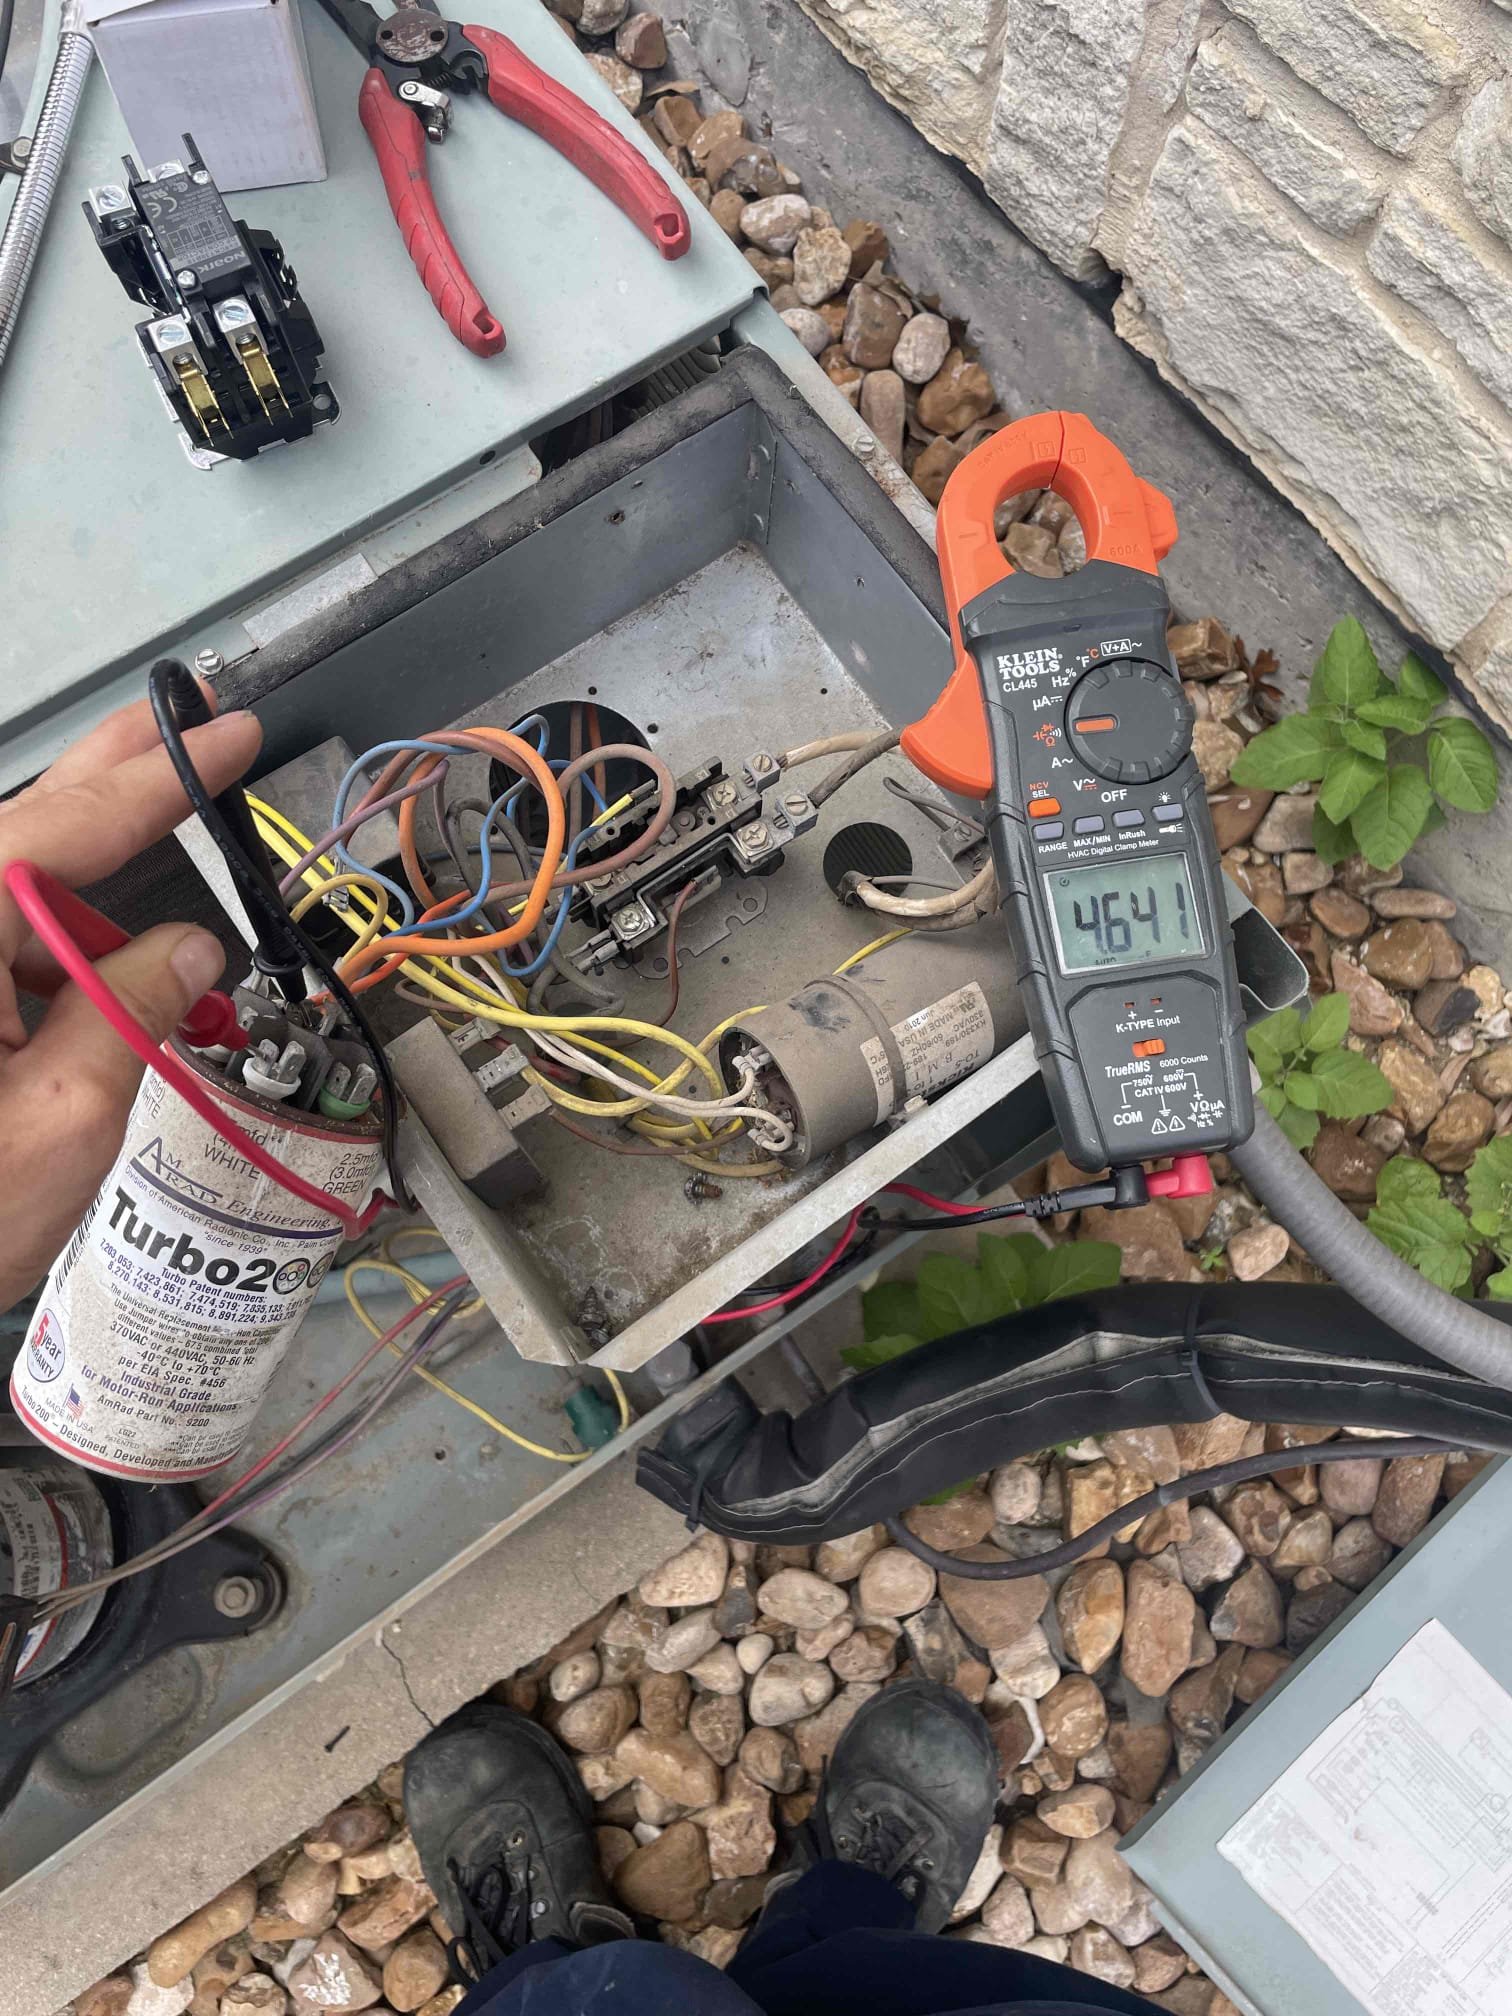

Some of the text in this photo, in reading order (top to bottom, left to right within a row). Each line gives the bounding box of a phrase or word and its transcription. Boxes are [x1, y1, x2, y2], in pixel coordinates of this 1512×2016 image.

[997, 648, 1058, 668] KLEIN
[999, 660, 1061, 680] TOOLS
[1002, 678, 1038, 693] CL445
[1029, 781, 1050, 791] NCV
[1032, 789, 1050, 799] SEL
[1101, 788, 1128, 803] OFF
[1073, 834, 1111, 848] MAX/MIN
[1118, 829, 1147, 841] InRush
[1038, 841, 1068, 854] RANGE
[1067, 838, 1160, 860] HVAC Digital Clamp Meter
[898, 1012, 955, 1048] MADE IN USA
[1116, 1015, 1181, 1033] K-TYPE Input
[1105, 1054, 1209, 1078] TrueRMS 6000 Counts
[1134, 1083, 1187, 1098] CAT IV 600V
[1113, 1110, 1143, 1126] COM
[204, 1143, 261, 1181] WHITE
[322, 1179, 367, 1195] GREEN
[125, 1164, 149, 1193] Division
[160, 1195, 203, 1225] American
[204, 1220, 249, 1242] Radionic
[161, 1266, 268, 1304] Turbo Patent numbers:
[110, 1282, 122, 1297] The
[122, 1291, 157, 1316] Universal
[158, 1310, 211, 1333] Replacement
[114, 1297, 127, 1311] Use
[128, 1307, 157, 1326] Jumper
[41, 1331, 62, 1361] year
[110, 1321, 256, 1367] 370VAC or 440VAC, 50-60 Hz
[117, 1313, 149, 1335] different
[150, 1329, 177, 1345] values
[203, 1345, 242, 1355] combined
[117, 1355, 140, 1371] per
[140, 1362, 160, 1378] EIA
[163, 1370, 195, 1387] Spec.
[171, 1360, 184, 1372] to
[187, 1364, 222, 1377] +70°C
[81, 1364, 238, 1415] for Motor-Run Applications
[120, 1369, 213, 1402] Industrial Grade
[45, 1397, 95, 1434] MADE IN USA
[96, 1393, 135, 1416] AmRad
[136, 1407, 159, 1423] Part
[185, 1418, 211, 1428] 9200
[60, 1424, 108, 1458] Designed,
[112, 1449, 172, 1468] Developed
[173, 1458, 193, 1468] and
